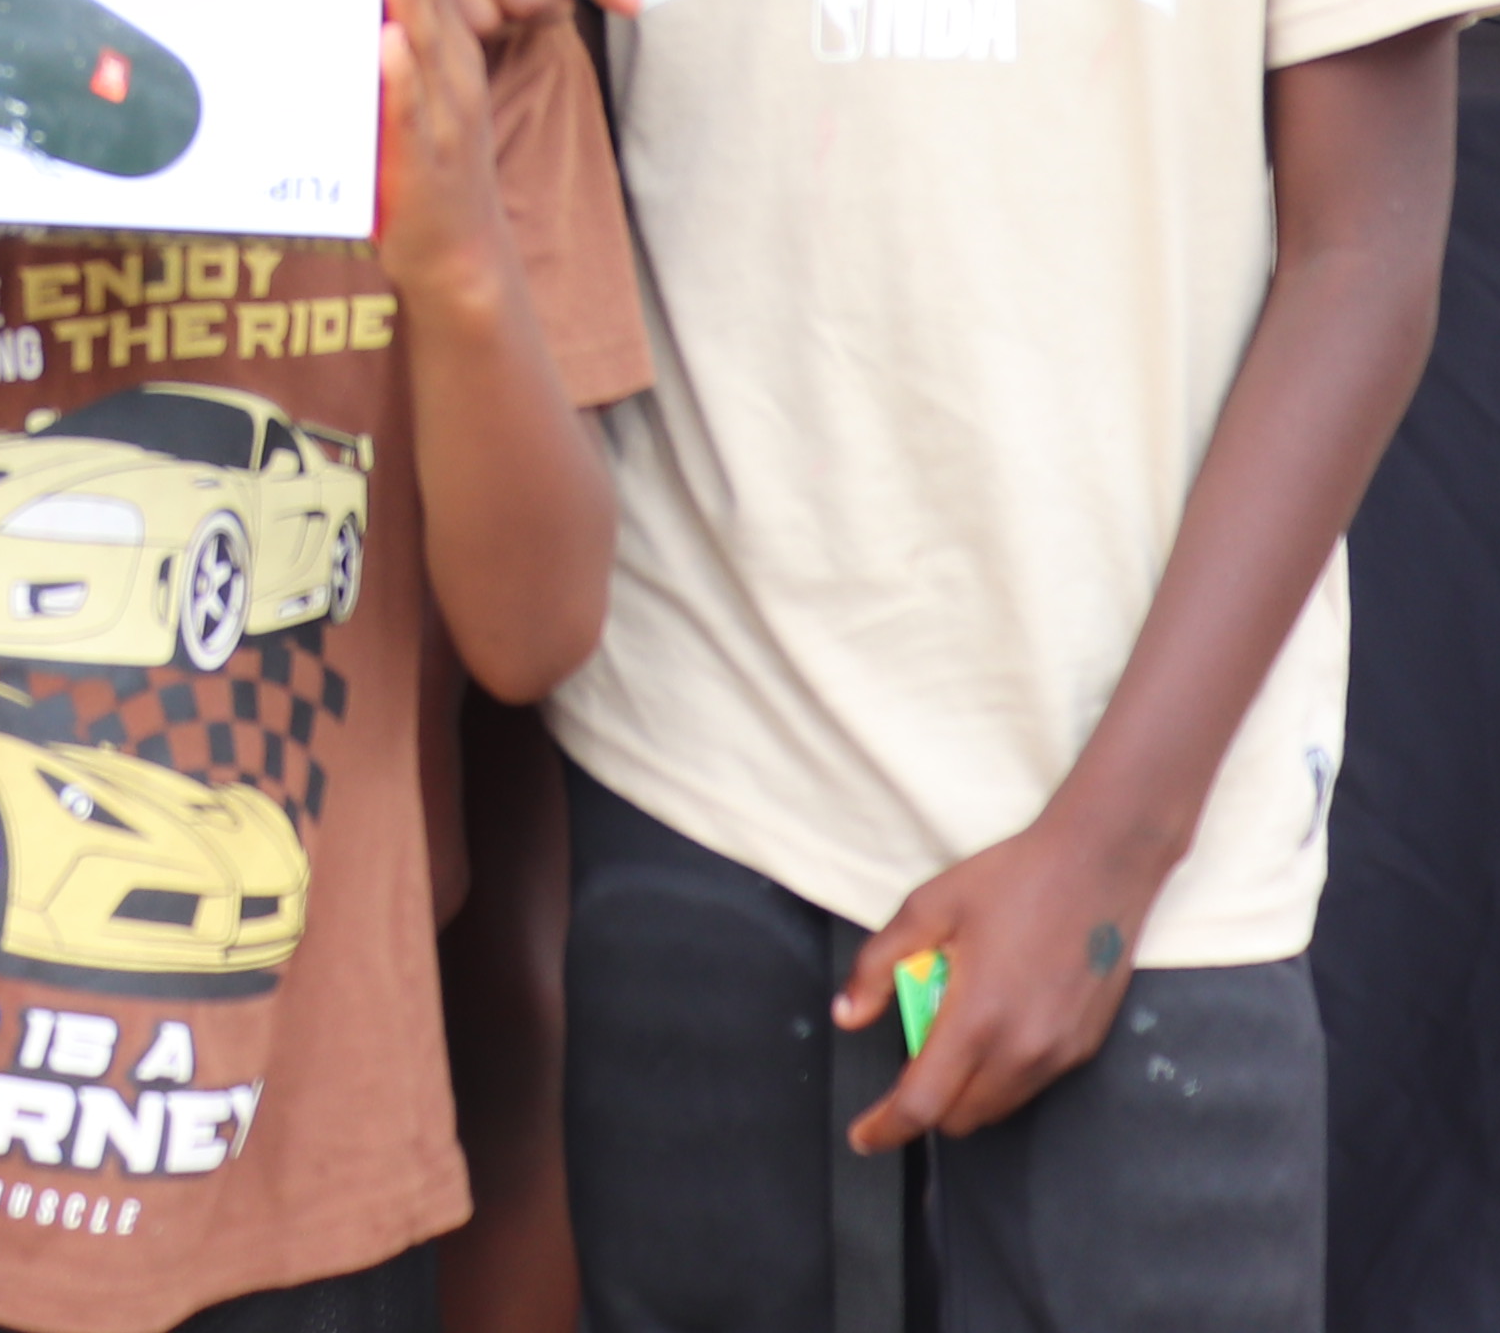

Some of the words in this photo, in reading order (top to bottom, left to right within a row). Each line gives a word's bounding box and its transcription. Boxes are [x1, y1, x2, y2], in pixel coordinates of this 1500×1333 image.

[18, 243, 284, 323] ENJOY
[53, 301, 228, 373] THE
[236, 294, 398, 360] RIDE
[18, 1007, 119, 1078] IS
[135, 1020, 195, 1084] A
